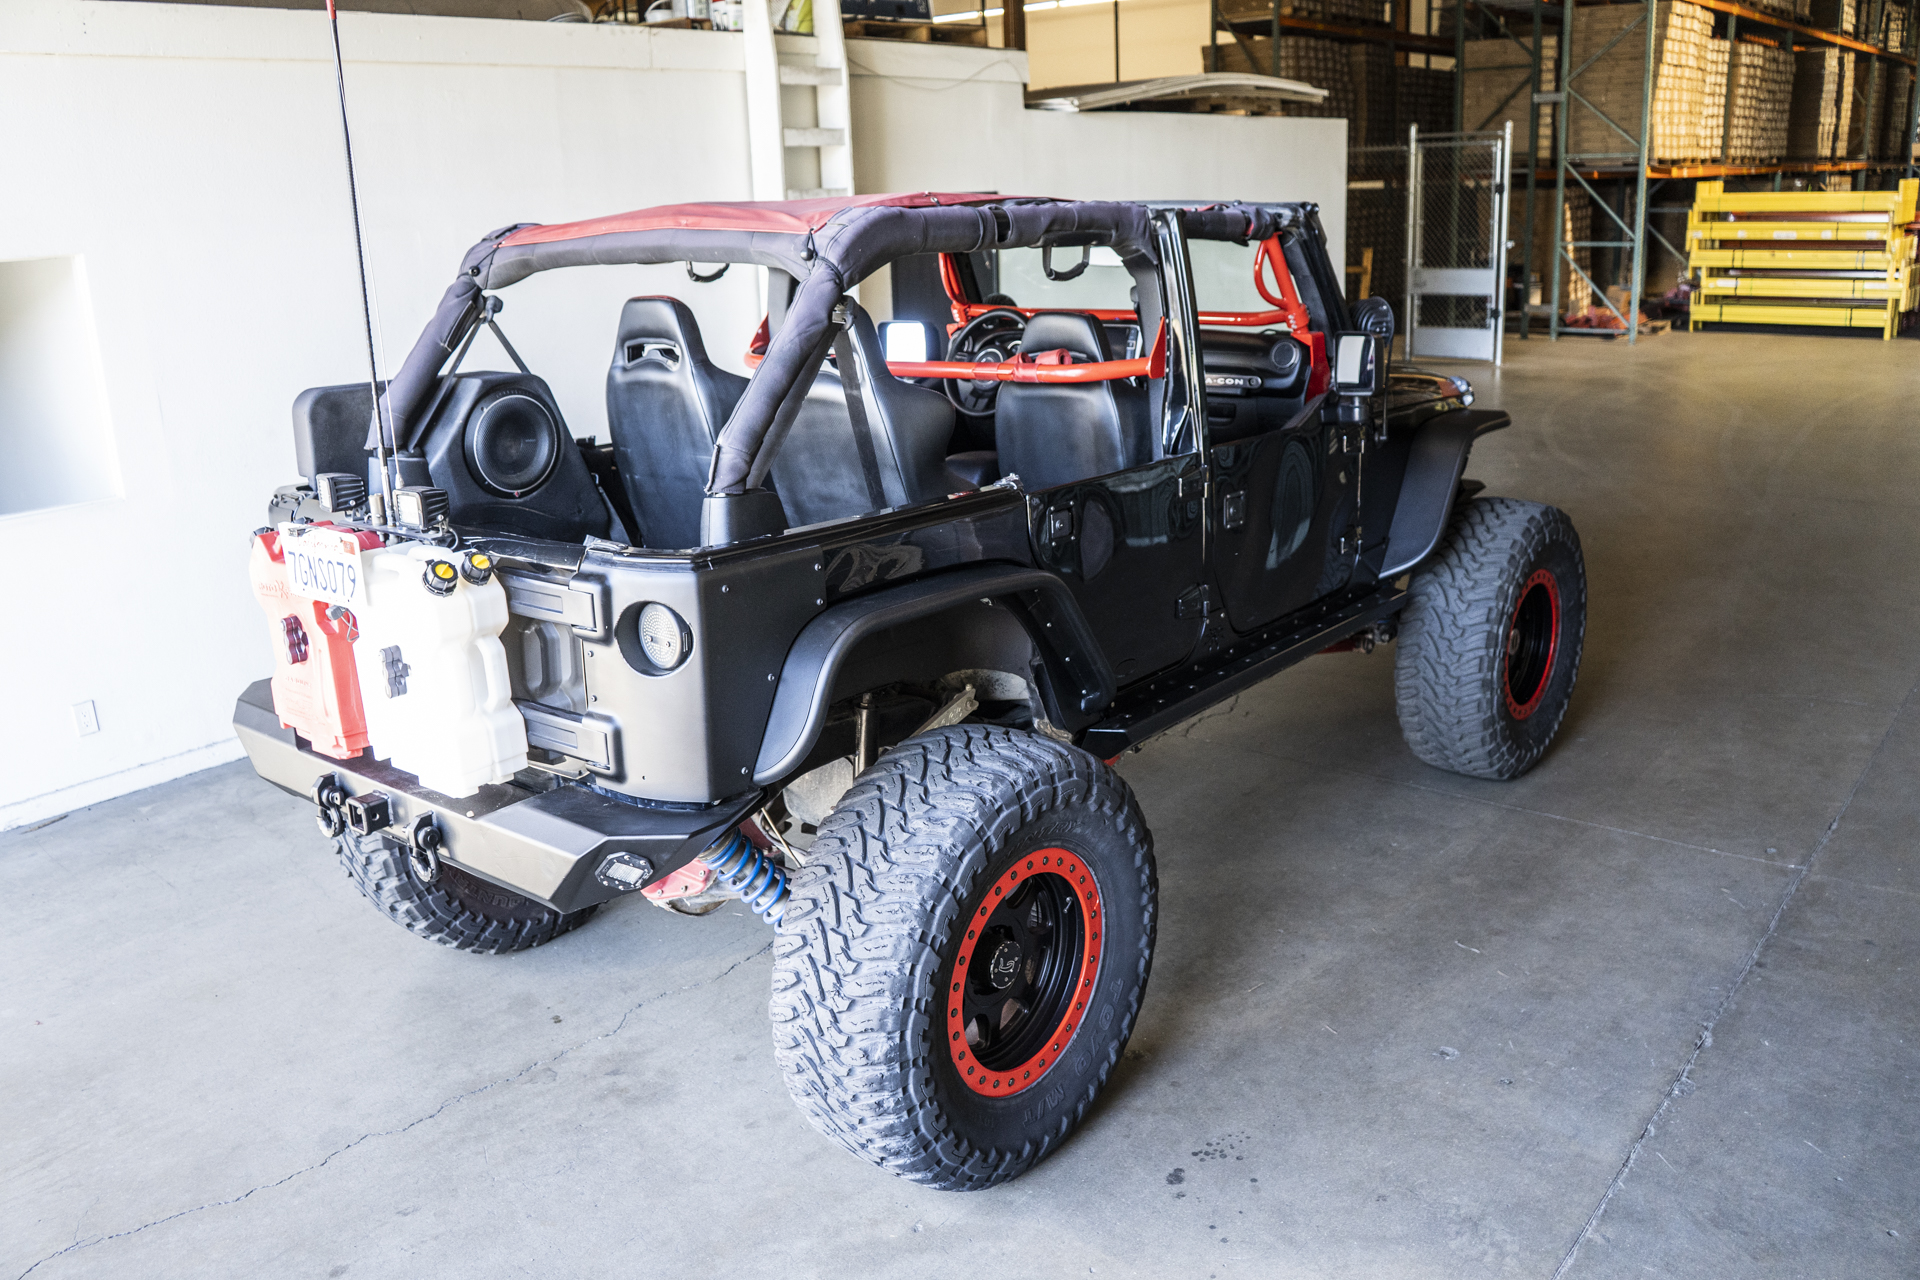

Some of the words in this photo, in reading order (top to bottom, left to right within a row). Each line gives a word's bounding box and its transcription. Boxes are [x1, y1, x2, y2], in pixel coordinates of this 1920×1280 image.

[288, 550, 356, 598] 7GNS079
[1075, 978, 1124, 1076] TOYO
[1023, 1084, 1065, 1128] M/T
